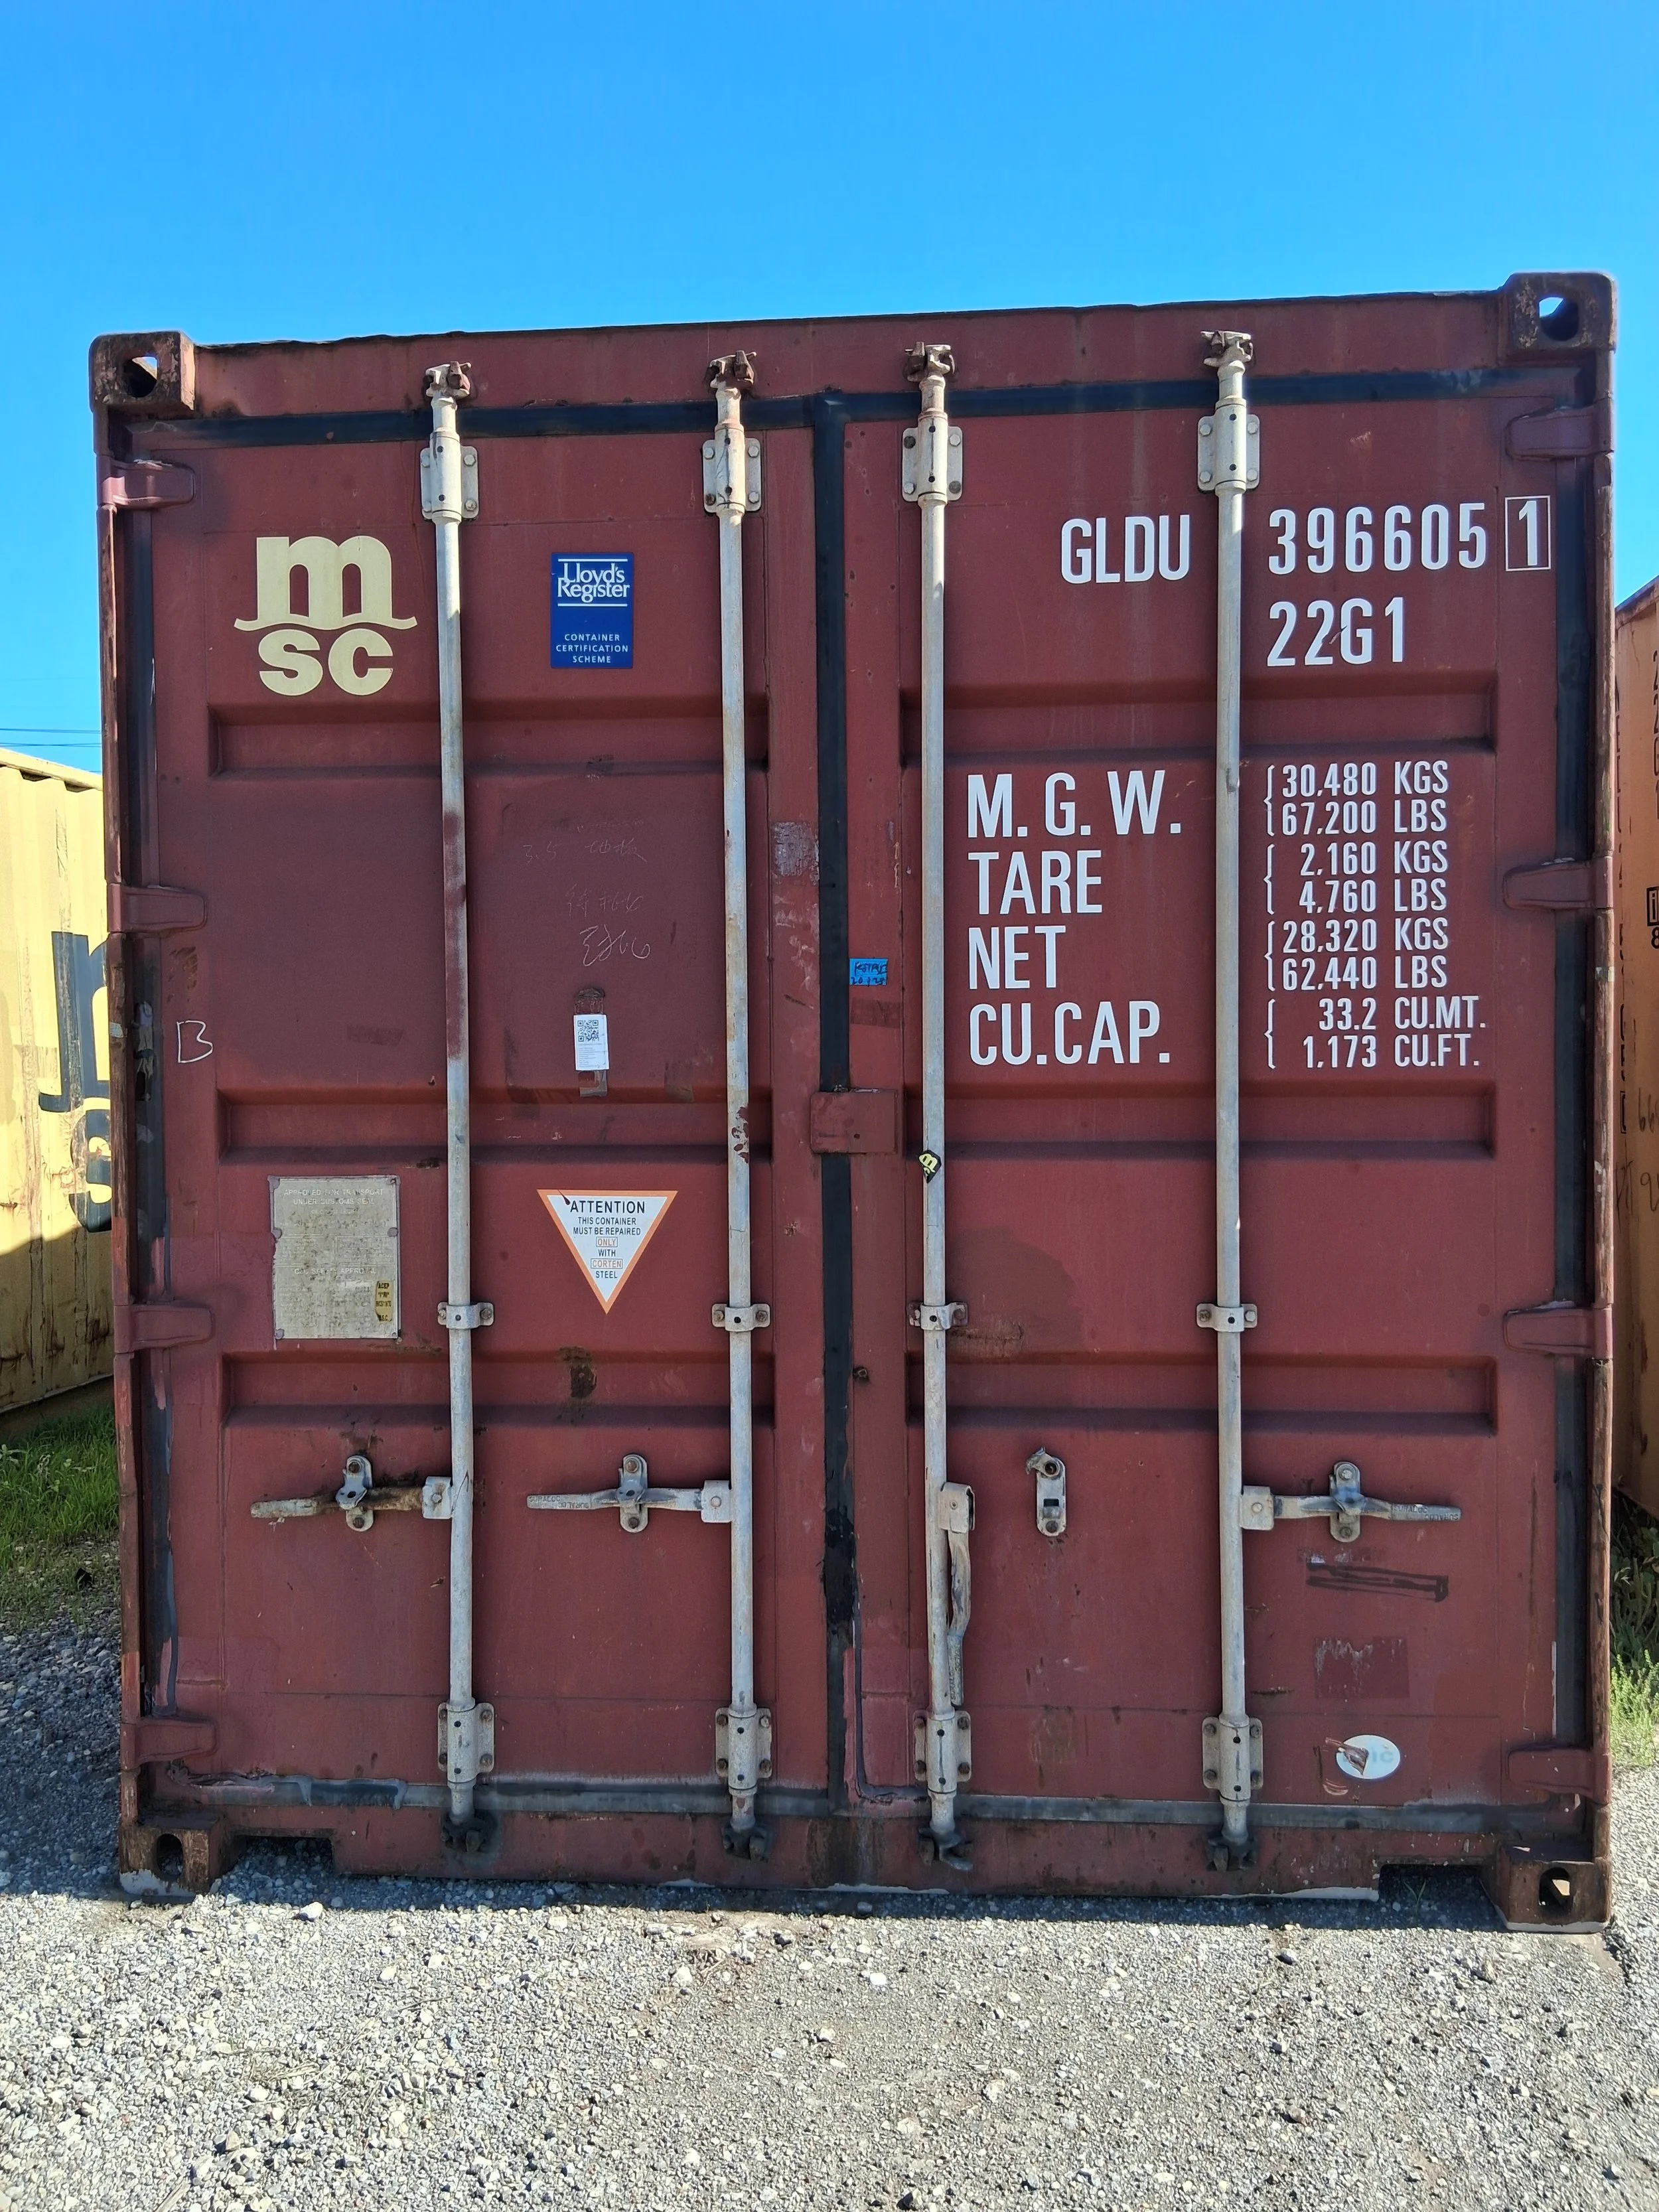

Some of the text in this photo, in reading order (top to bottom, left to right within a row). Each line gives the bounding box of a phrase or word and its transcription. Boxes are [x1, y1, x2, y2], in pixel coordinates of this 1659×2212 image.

[1062, 500, 1538, 584] GLDU 396605 1
[558, 577, 630, 603] Register
[564, 563, 625, 586] Lloyd's
[1267, 597, 1404, 666] 22G1
[1283, 761, 1448, 797] 30,480 KGS
[968, 770, 1181, 838] M. G. W.
[1283, 798, 1447, 835] 67,200 LBS
[1301, 840, 1448, 876] 2,160 KGS
[968, 850, 1102, 915] TARE
[1299, 878, 1447, 913] 4,760 LBS
[1283, 917, 1448, 953] 28,320 KGS
[969, 926, 1066, 990] NET
[1283, 955, 1447, 990] 62,440 LBS
[1319, 995, 1486, 1030] 33.2 CU.MT.
[176, 1019, 214, 1063] B
[970, 1000, 1170, 1065] CU.CAP.
[1303, 1033, 1479, 1069] 1,173 CU.FT.
[570, 1200, 645, 1214] ATTENTION
